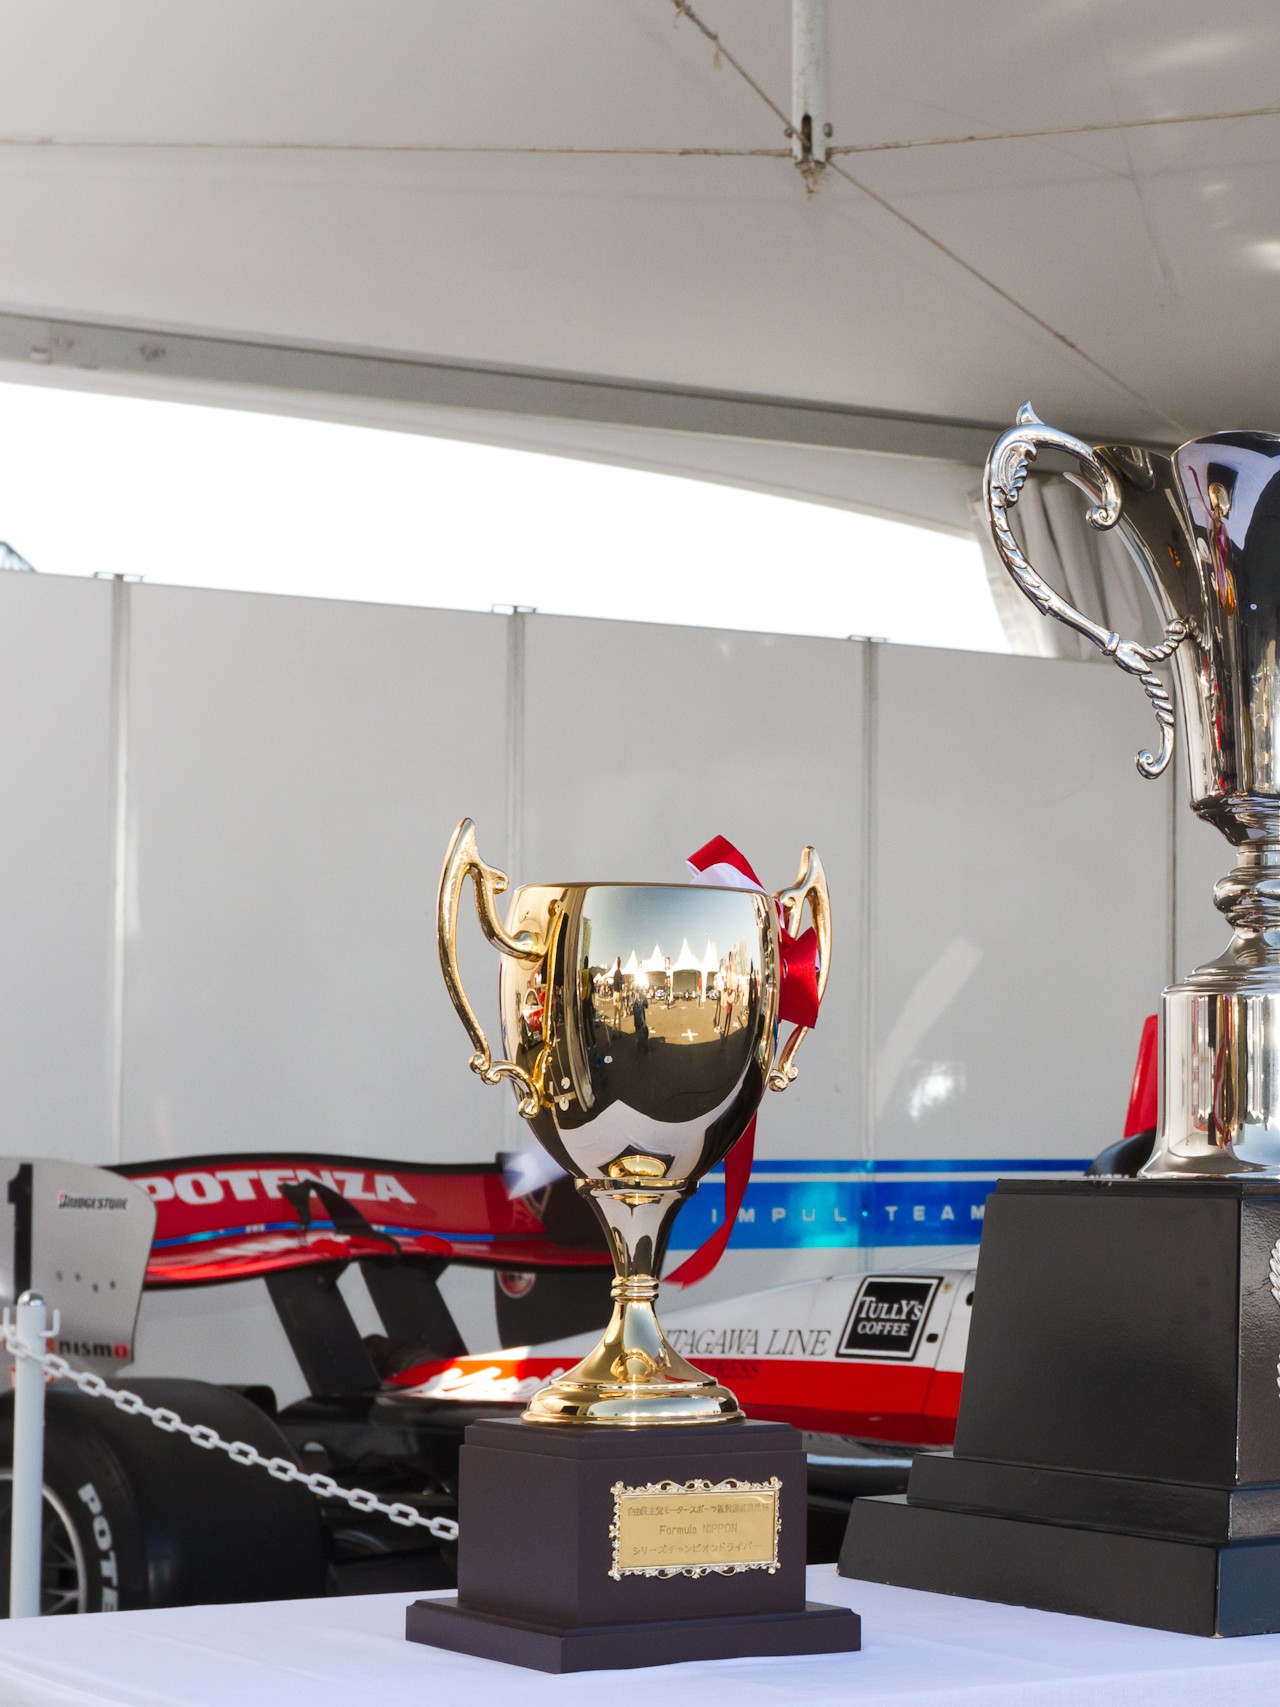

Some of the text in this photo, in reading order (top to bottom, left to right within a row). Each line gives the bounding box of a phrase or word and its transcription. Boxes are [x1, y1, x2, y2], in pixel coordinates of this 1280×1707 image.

[130, 1169, 417, 1204] POTENZA
[57, 1192, 129, 1210] BRIDGESTONE
[8, 1164, 33, 1305] 1
[857, 1321, 910, 1336] COFFEE
[664, 1329, 831, 1356] TAGAWA LINE
[659, 1523, 738, 1536] Formula NIPPON
